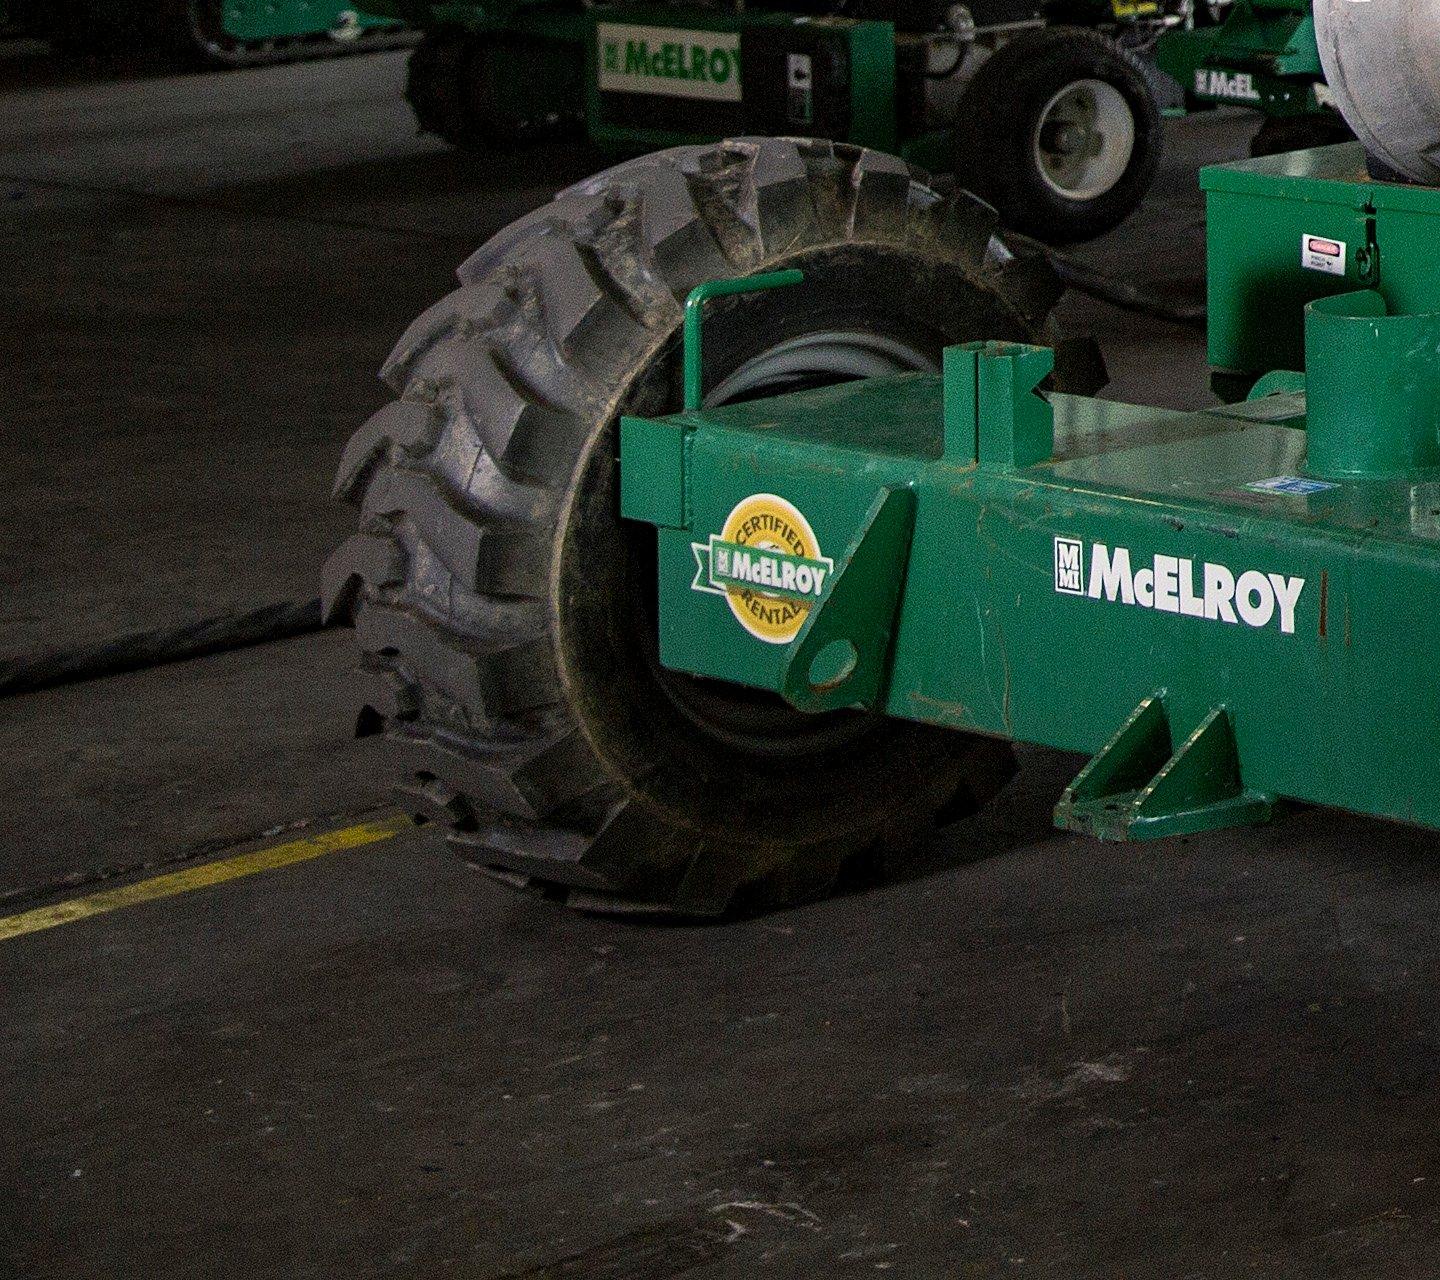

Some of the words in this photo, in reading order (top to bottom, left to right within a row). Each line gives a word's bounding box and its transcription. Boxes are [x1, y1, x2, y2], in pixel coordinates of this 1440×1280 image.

[735, 513, 805, 557] CERTIFIED
[731, 551, 827, 596] McELROY
[1088, 543, 1306, 634] McELROY
[740, 590, 802, 625] RENTAL
